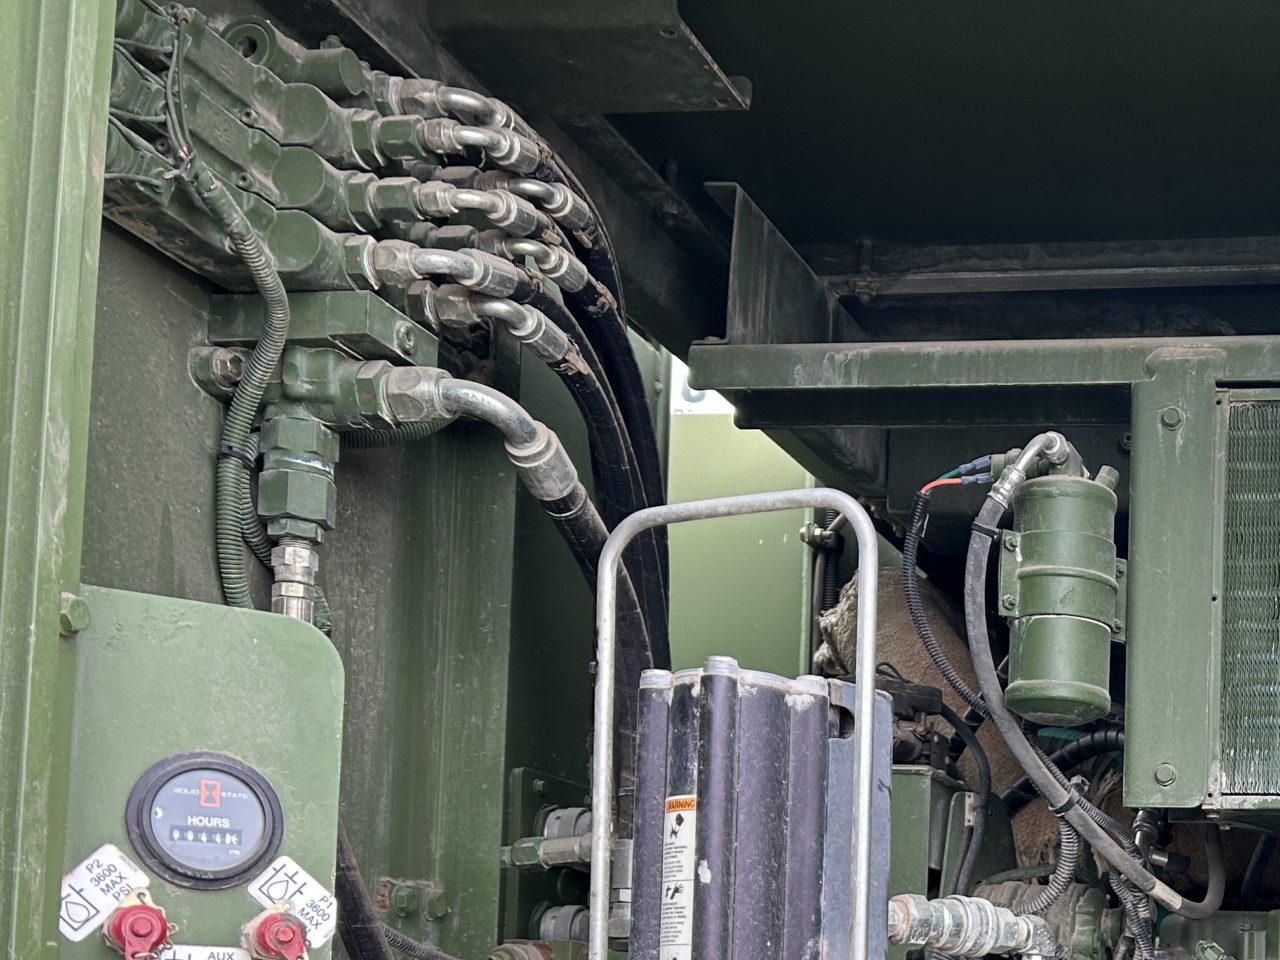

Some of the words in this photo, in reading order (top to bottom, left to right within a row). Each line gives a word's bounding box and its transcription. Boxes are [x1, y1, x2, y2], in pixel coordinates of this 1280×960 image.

[221, 791, 248, 800] STATE
[187, 815, 230, 828] HOURS
[85, 858, 103, 874] P2
[90, 863, 117, 887] 3600
[99, 872, 127, 895] MAX
[112, 883, 133, 902] PSI
[318, 895, 333, 909] P1
[298, 907, 323, 929] MAX
[306, 900, 331, 922] 3600
[207, 951, 235, 960] AUX
